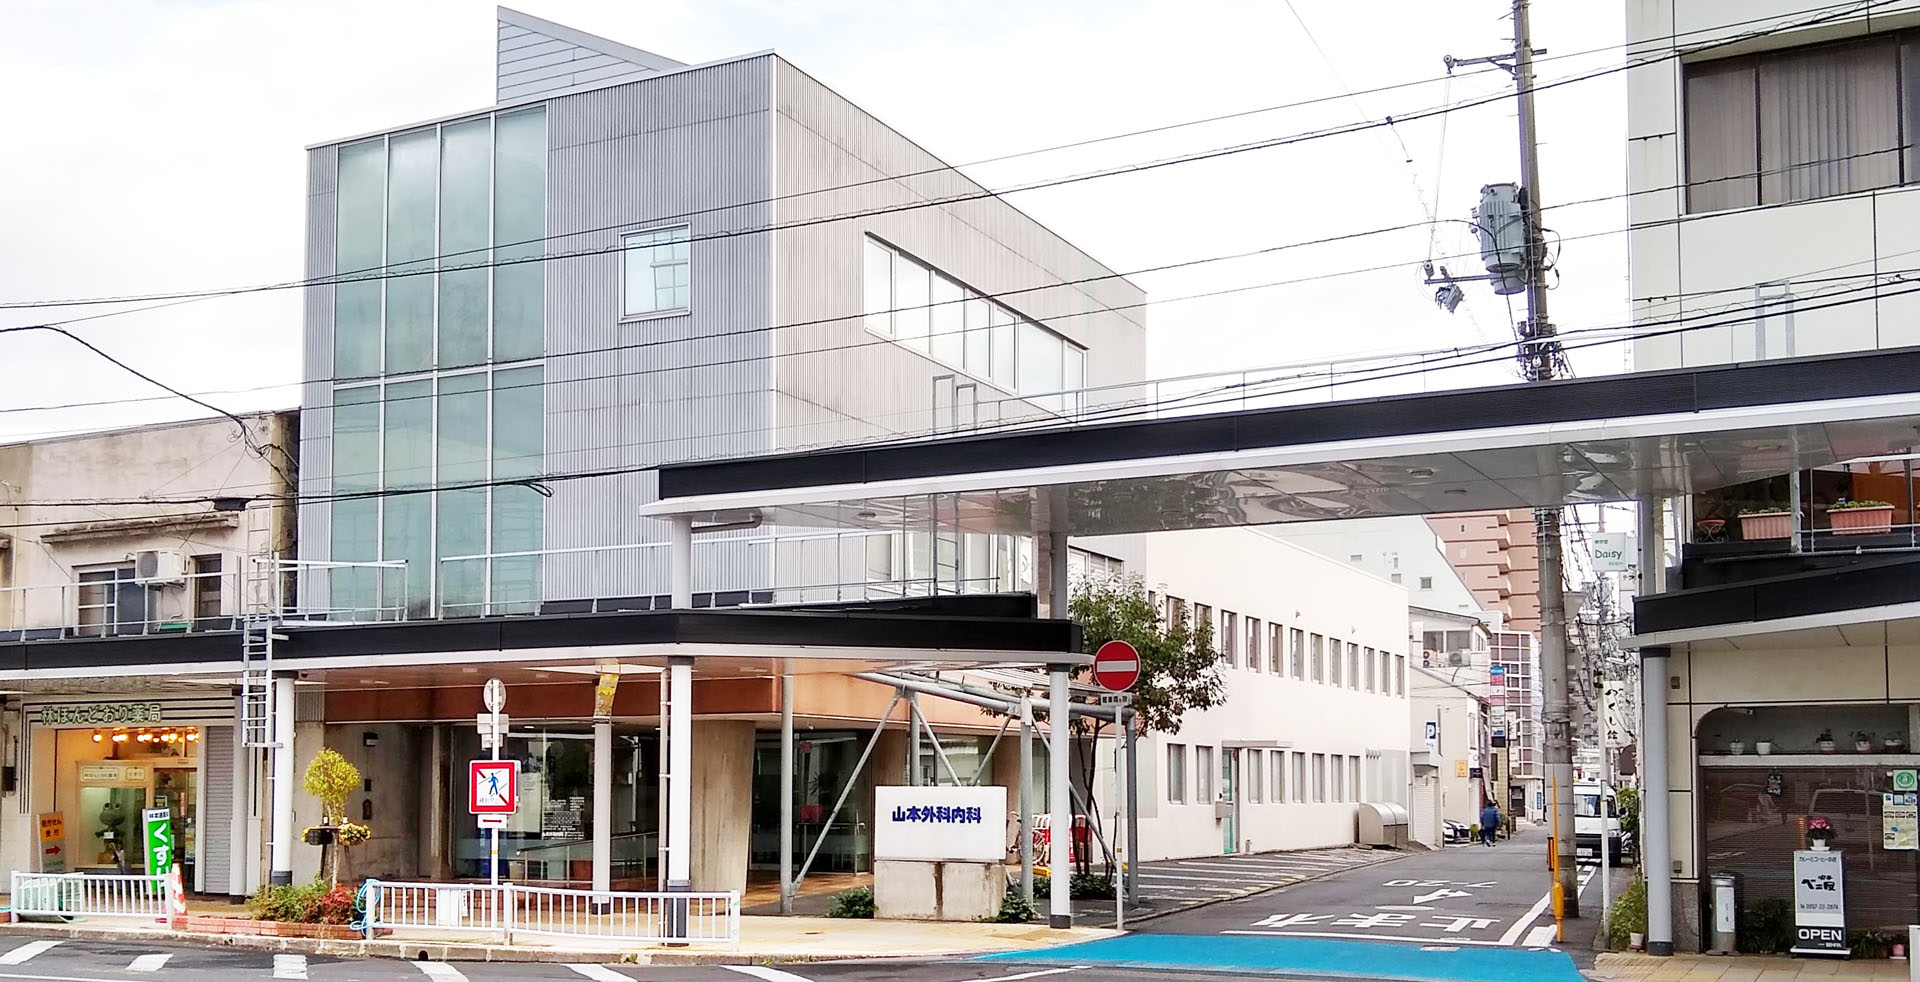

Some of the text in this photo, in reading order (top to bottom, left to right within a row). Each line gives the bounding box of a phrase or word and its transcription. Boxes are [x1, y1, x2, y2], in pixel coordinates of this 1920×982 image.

[1595, 549, 1622, 560] Daisy
[41, 703, 162, 725] 林ほんどおり薬局
[892, 805, 981, 823] 山本外科内科
[1250, 912, 1501, 932] 止まれ
[1798, 929, 1842, 941] OPEN
